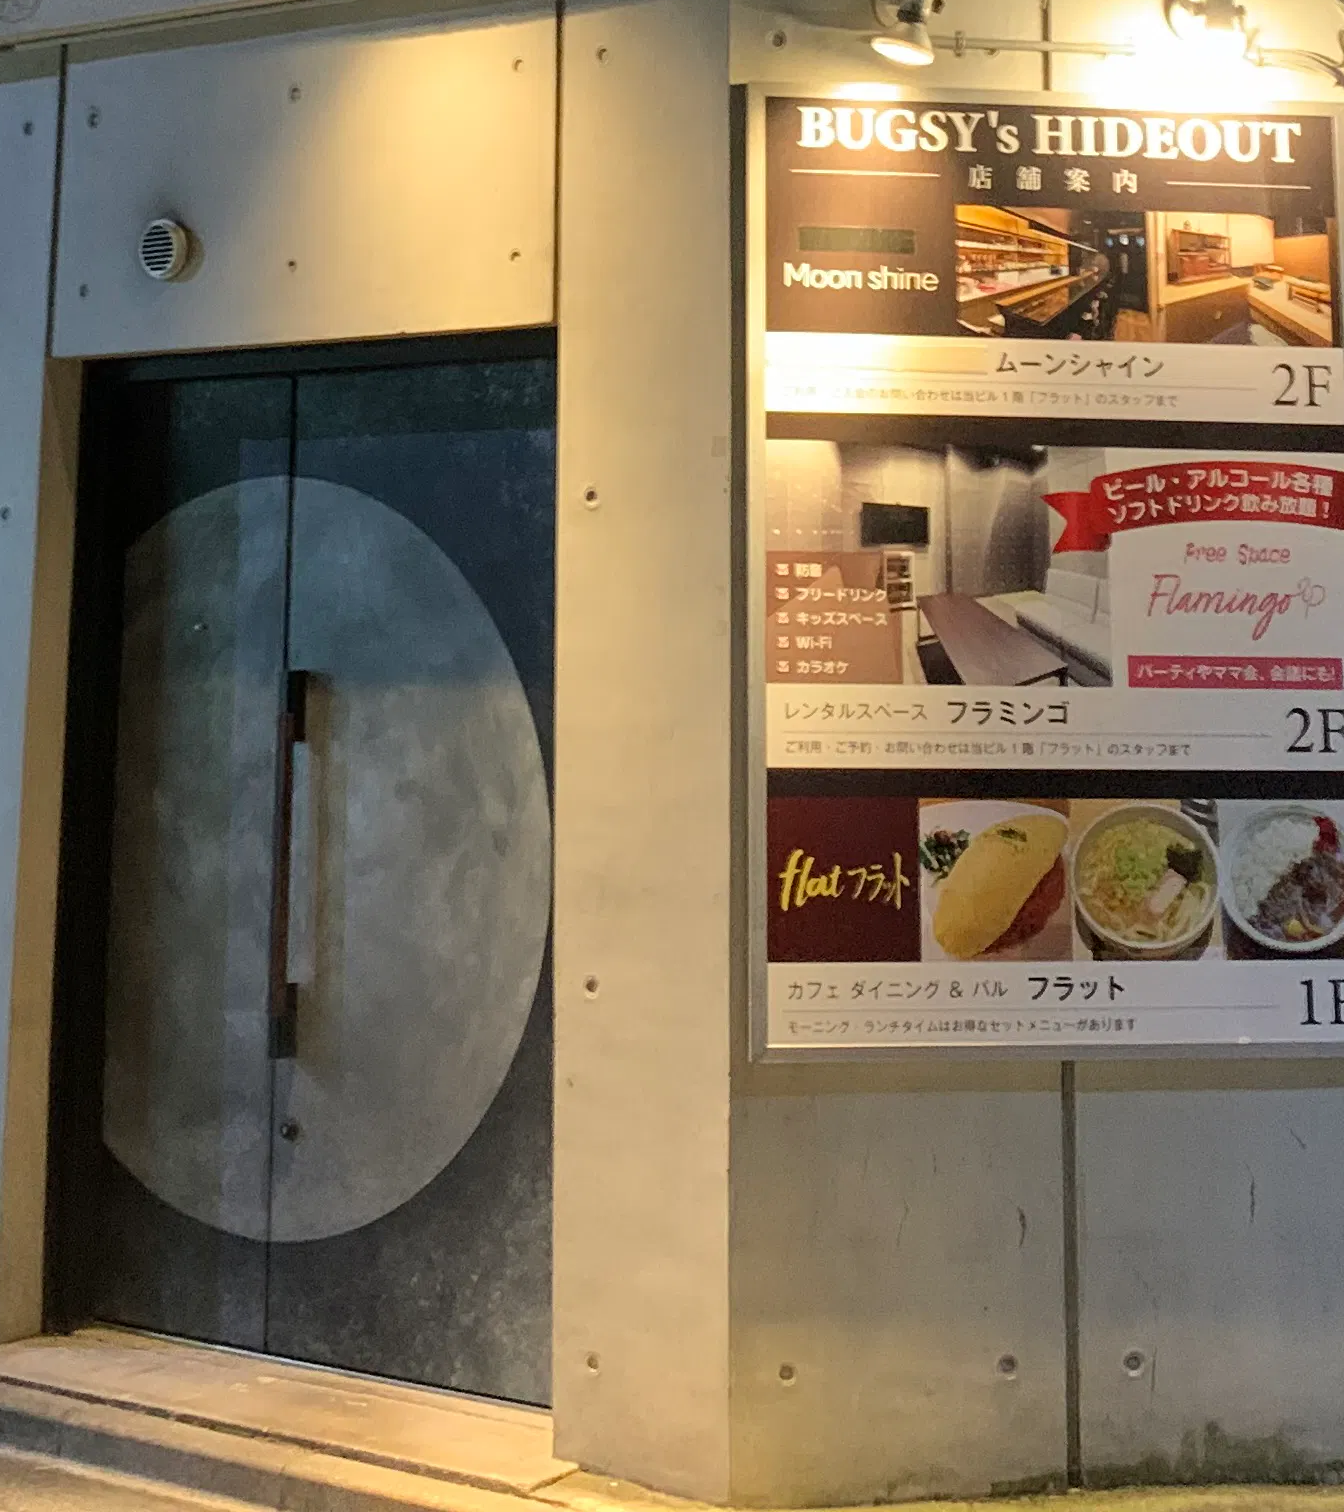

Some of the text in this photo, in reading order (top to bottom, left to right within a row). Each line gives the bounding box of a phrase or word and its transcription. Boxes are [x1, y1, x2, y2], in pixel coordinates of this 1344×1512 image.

[796, 105, 1301, 164] BUGSY's HIDEOUT
[968, 164, 1139, 194] 店舗案内
[783, 262, 939, 292] Moon shine
[995, 352, 1164, 378] ムーンシャイン
[1270, 363, 1331, 407] 2F
[1103, 468, 1334, 500] ビール・アルコール各種
[1108, 492, 1330, 524] ソフトドリンク飲み放題!
[1184, 543, 1291, 565] Free Space
[795, 587, 887, 602] フリードリンク
[1147, 573, 1295, 640] Flamingo
[795, 611, 888, 626] キッズスペース
[795, 636, 832, 650] Wi-Fi
[796, 660, 849, 675] カラオケ
[784, 699, 1069, 726] レンタルスペース フラミンゴ
[779, 849, 844, 911] flat
[787, 975, 1124, 1001] カフェ ダイニング & バル フラット
